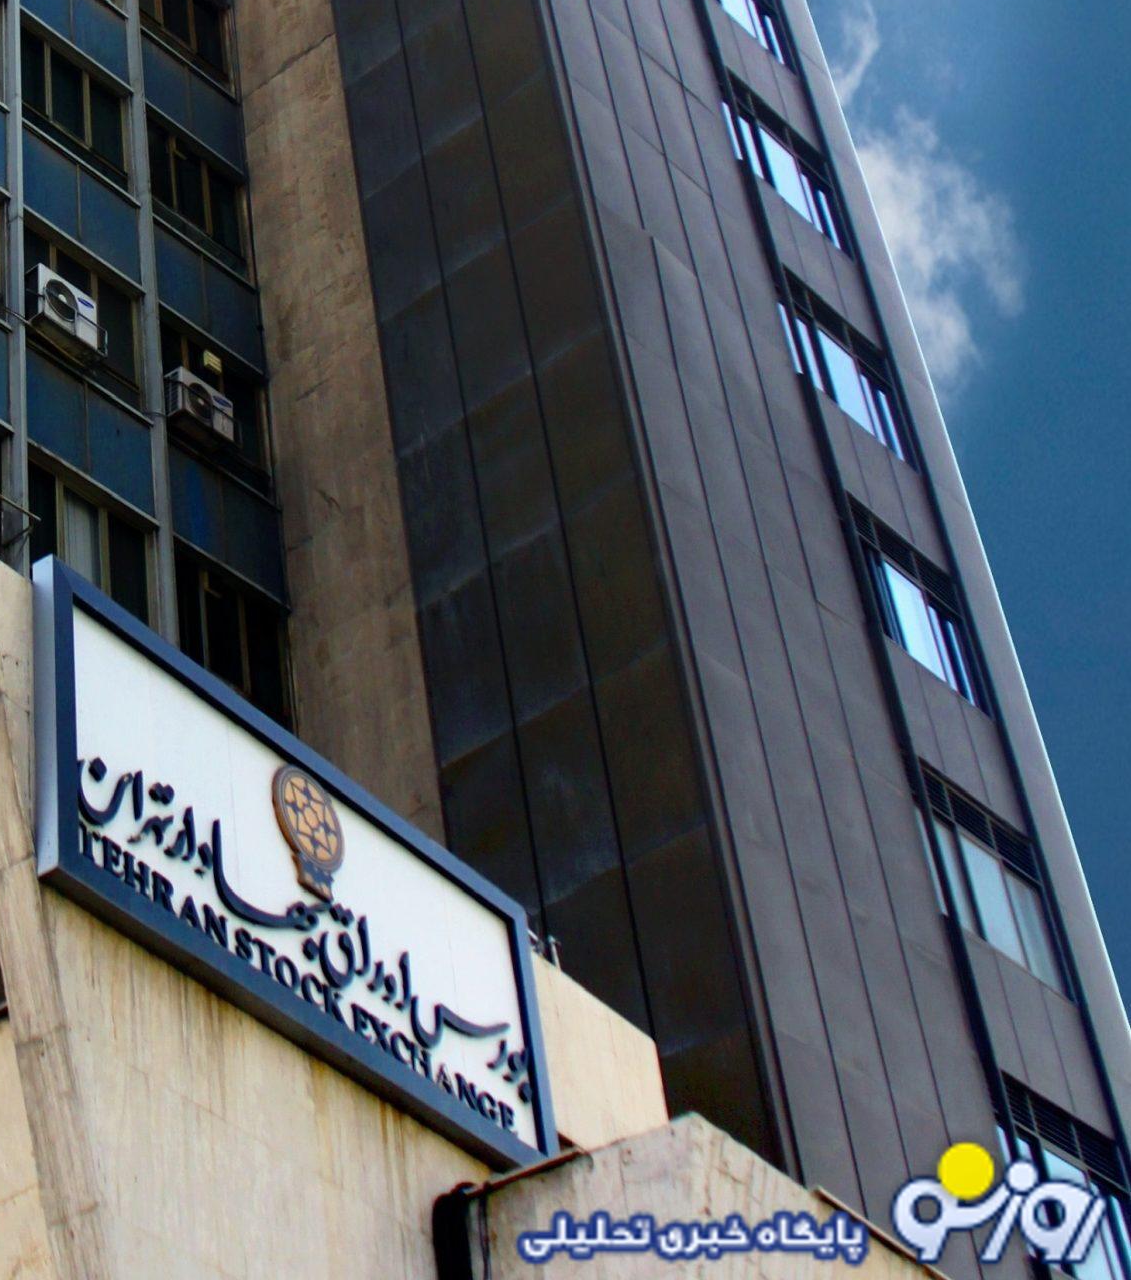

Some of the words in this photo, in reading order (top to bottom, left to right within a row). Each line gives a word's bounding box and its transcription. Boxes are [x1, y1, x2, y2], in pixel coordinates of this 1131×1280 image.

[78, 820, 229, 950] TEHRAN
[234, 927, 342, 1024] STOCK
[350, 1002, 516, 1131] EXCHANGE
